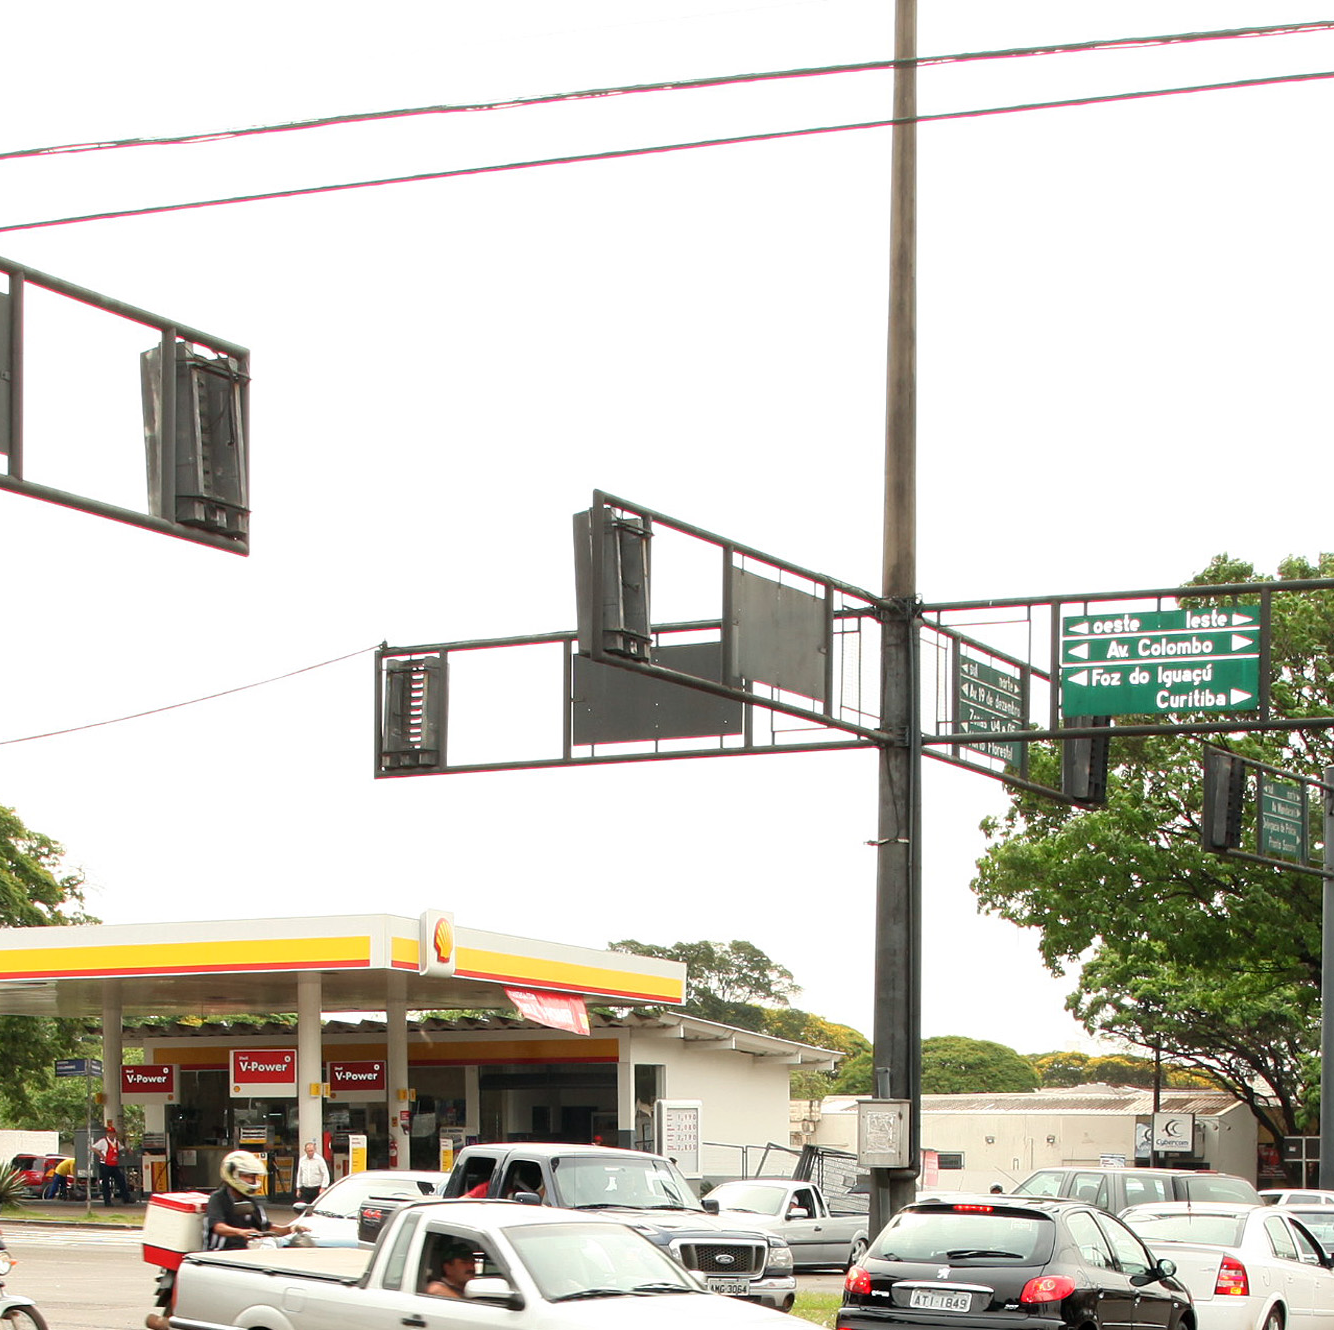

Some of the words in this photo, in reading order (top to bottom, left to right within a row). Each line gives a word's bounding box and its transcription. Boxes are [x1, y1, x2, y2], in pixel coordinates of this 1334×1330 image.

[1092, 613, 1141, 634] oeste
[1185, 608, 1228, 629] leste
[1106, 640, 1129, 659] Av.
[1137, 635, 1213, 657] Colombo
[998, 676, 1014, 693] norte
[1091, 668, 1122, 687] Foz
[1128, 666, 1151, 685] do
[1157, 663, 1213, 688] Iguaçú
[978, 687, 985, 702] 19
[986, 691, 993, 707] de
[1156, 688, 1227, 709] Curitiba
[239, 1061, 288, 1073] V-Power
[335, 1071, 378, 1081] V-Power
[126, 1073, 167, 1084] V-Power
